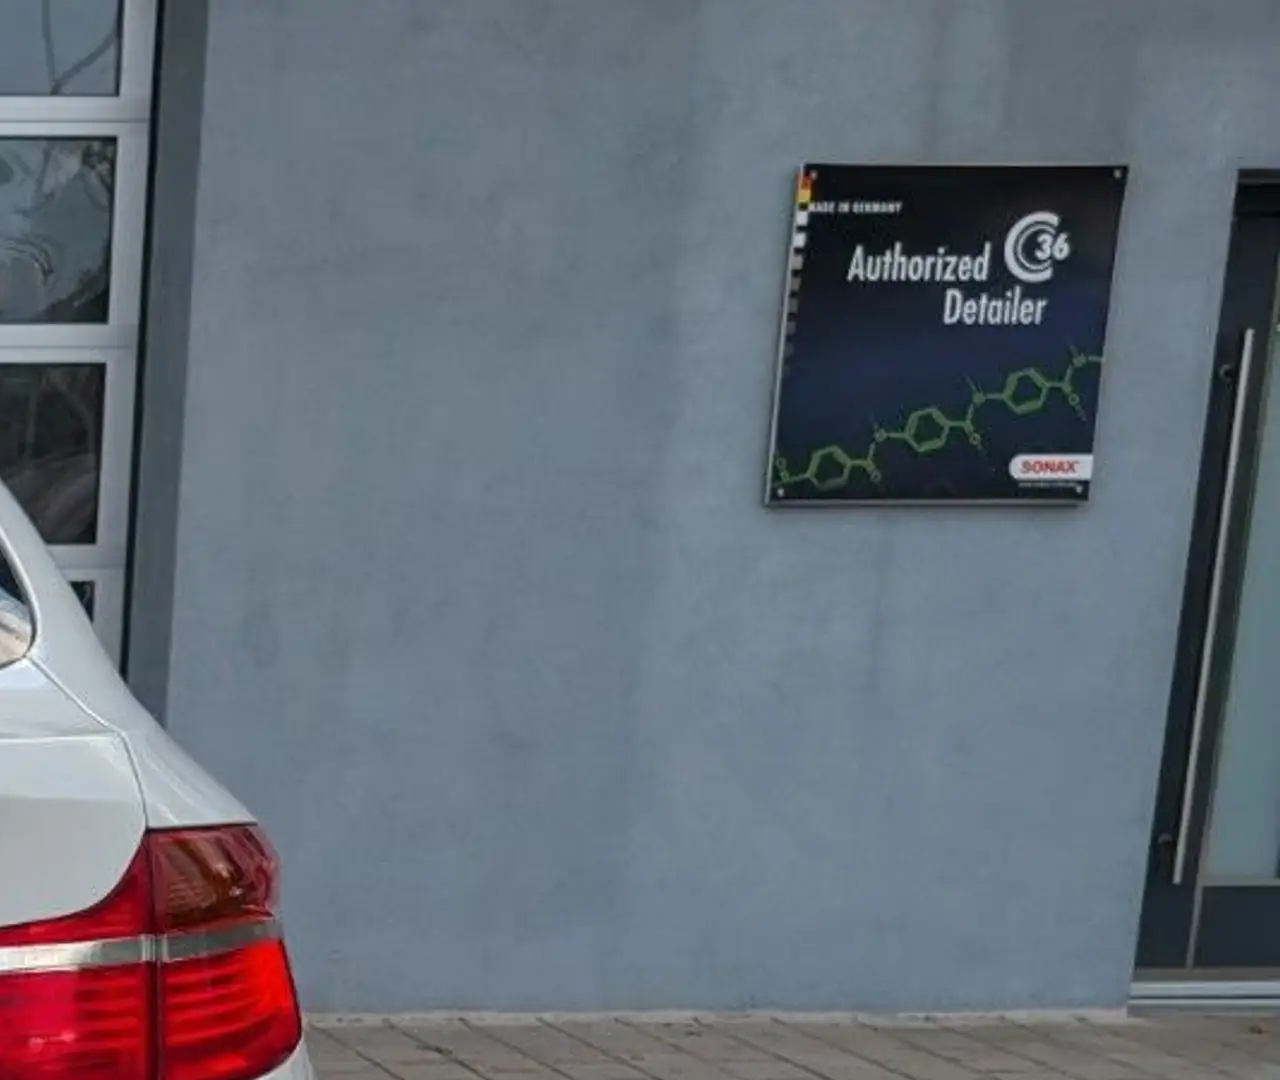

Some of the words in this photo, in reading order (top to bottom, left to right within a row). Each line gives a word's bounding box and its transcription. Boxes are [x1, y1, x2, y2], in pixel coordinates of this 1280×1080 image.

[847, 242, 991, 282] Authorized
[943, 286, 1048, 326] Detailer
[1020, 461, 1076, 474] SONAX
